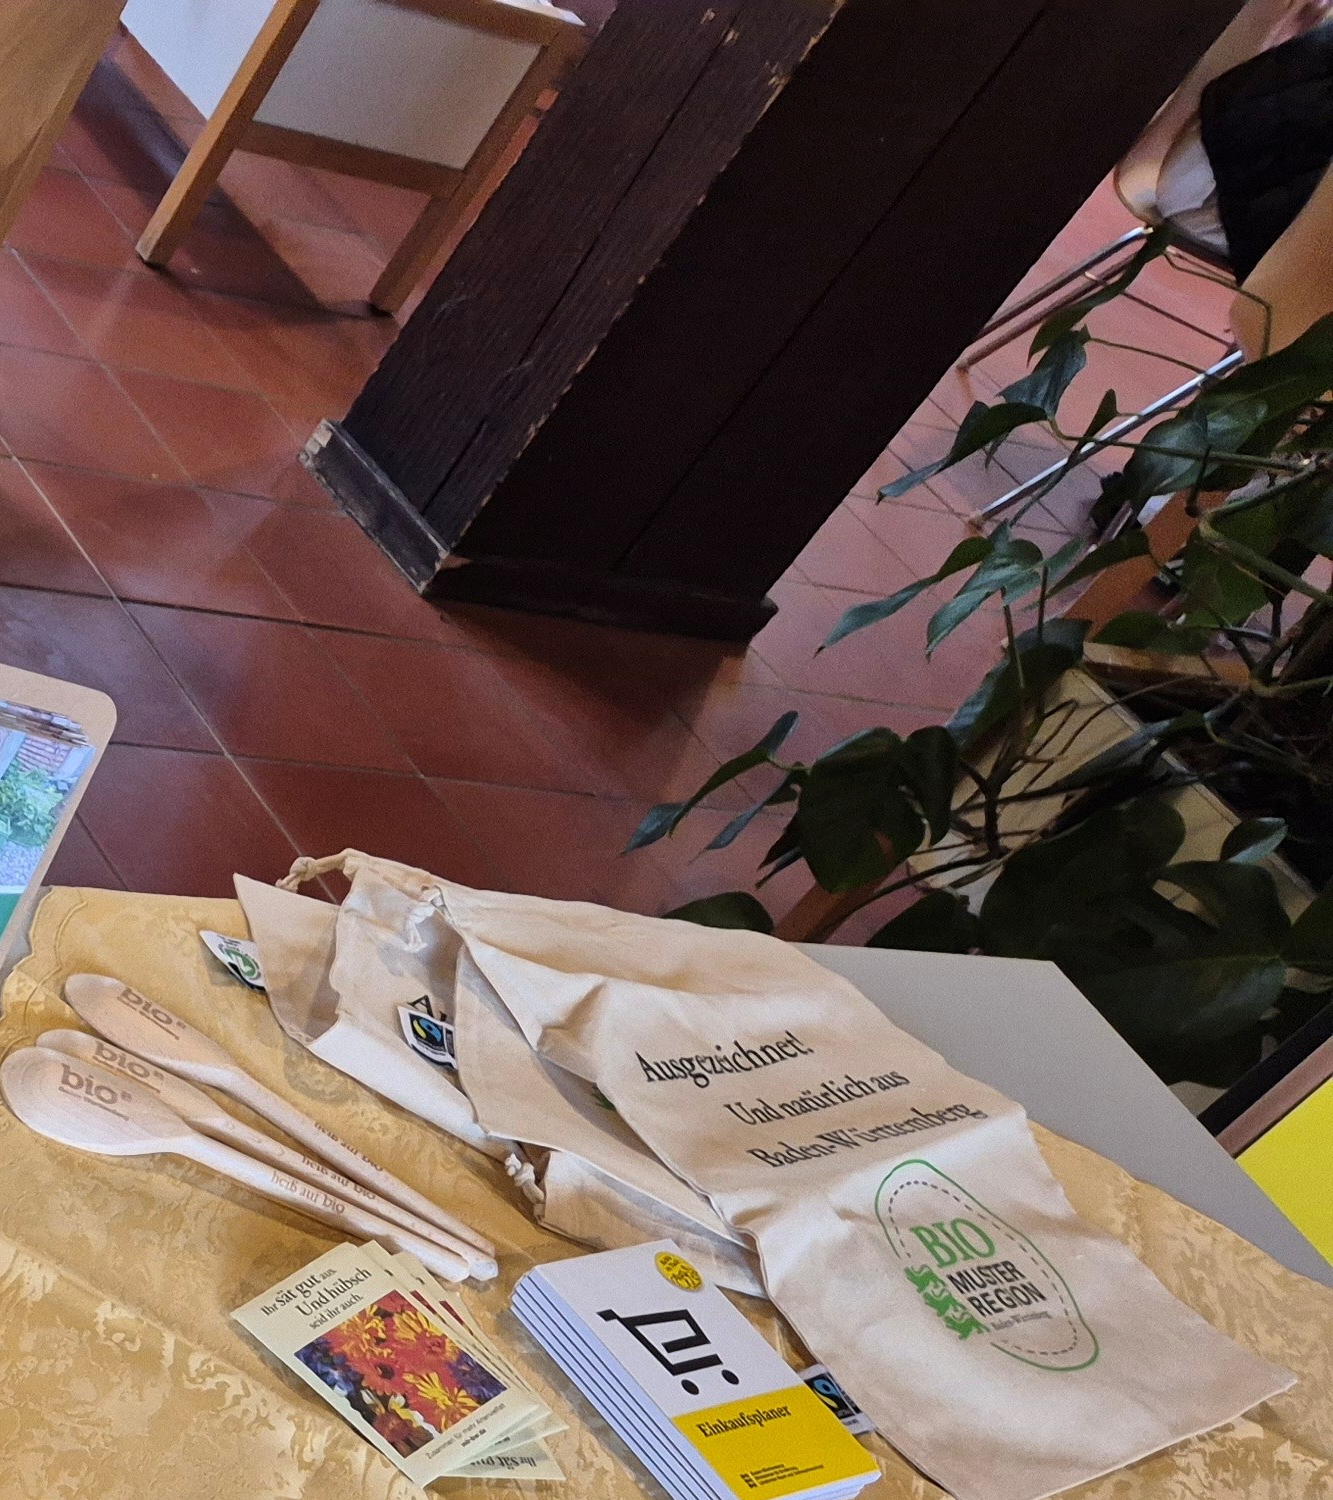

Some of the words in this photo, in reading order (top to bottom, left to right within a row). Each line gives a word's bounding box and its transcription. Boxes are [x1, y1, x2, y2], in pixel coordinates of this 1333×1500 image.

[120, 986, 173, 1026] bio
[92, 1040, 151, 1080] bio
[635, 1030, 815, 1089] Ausgezeichnet!
[60, 1062, 119, 1105] bio
[723, 1097, 784, 1126] Und
[778, 1074, 874, 1118] natürlich
[870, 1070, 911, 1094] aus
[746, 1103, 989, 1169] Baden-Württemberg
[909, 1217, 996, 1269] BIO
[260, 1301, 279, 1317] Ihr
[275, 1289, 298, 1307] sät
[294, 1274, 322, 1299] gut
[295, 1287, 331, 1317] Und
[324, 1267, 373, 1300] hübsch
[945, 1260, 1026, 1295] MUSTER
[966, 1281, 1048, 1318] REGION
[696, 1404, 792, 1438] Einkaufsplaner
